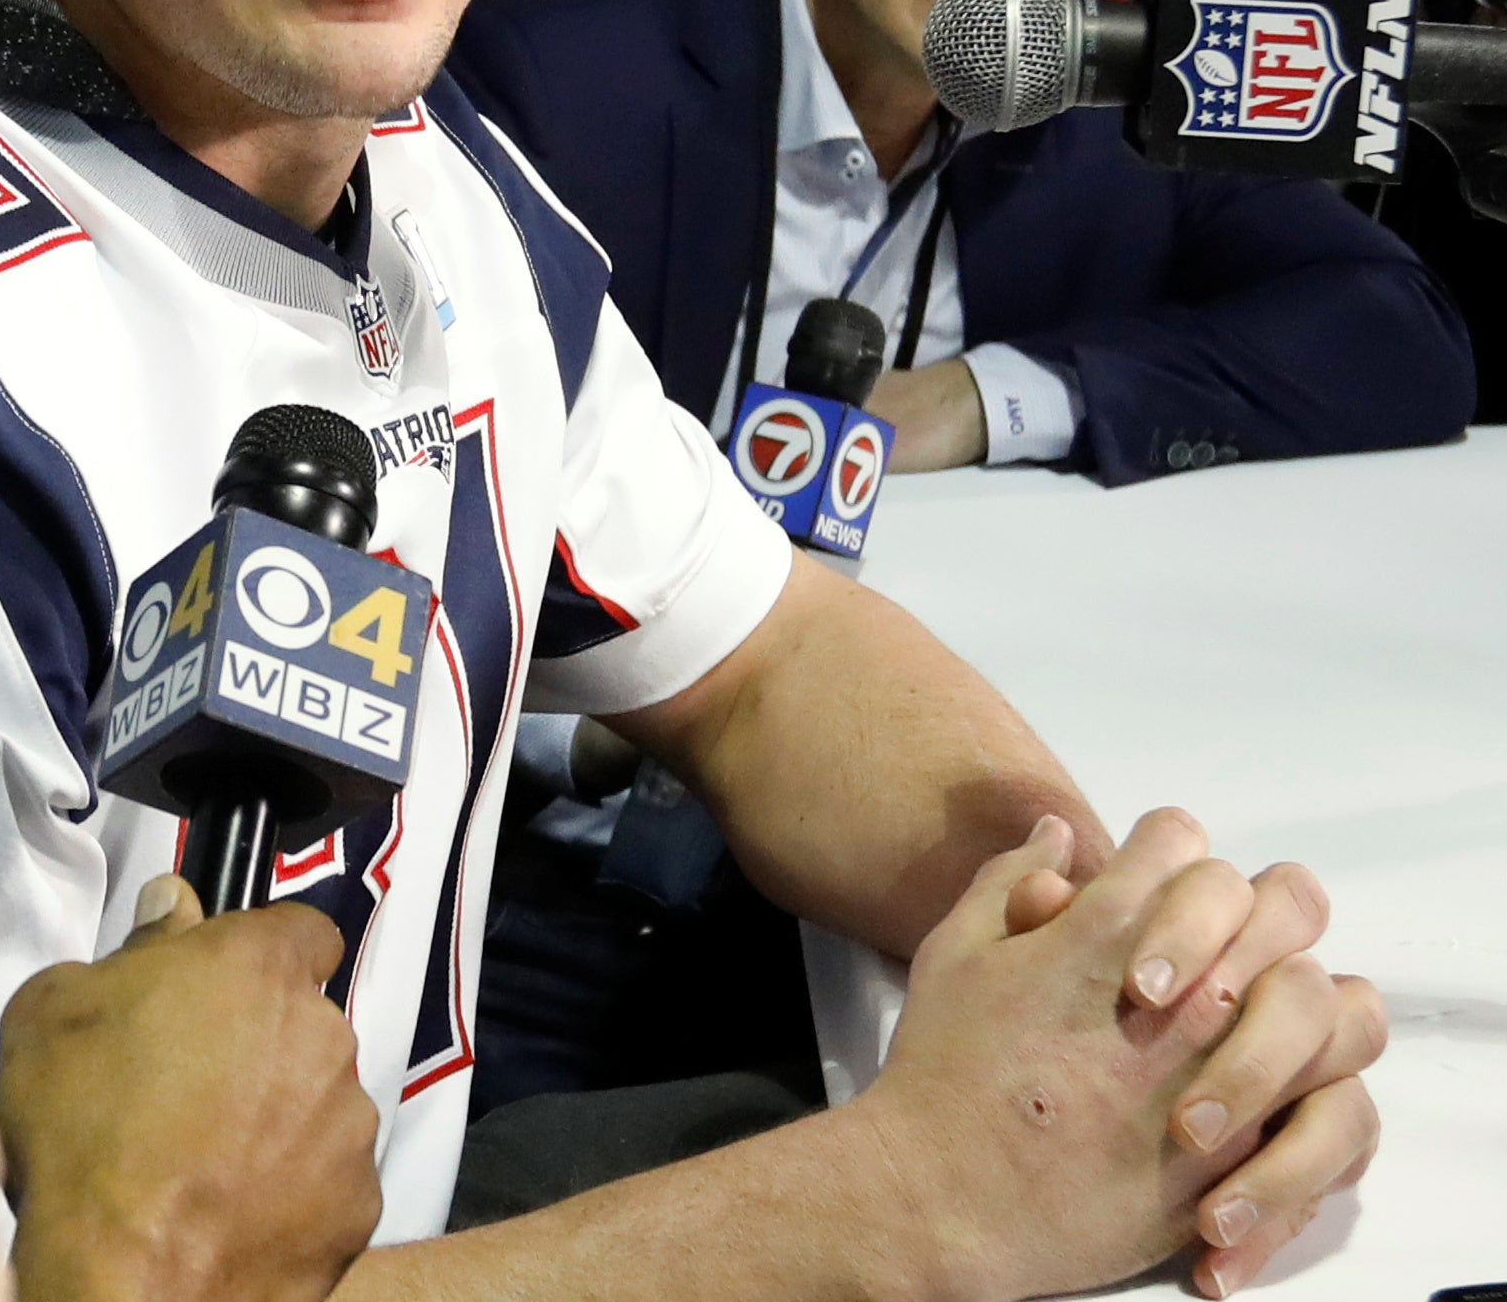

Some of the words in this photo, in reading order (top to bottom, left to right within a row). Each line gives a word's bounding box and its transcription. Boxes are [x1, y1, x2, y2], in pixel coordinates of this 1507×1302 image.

[1246, 19, 1327, 123] NFL
[370, 403, 455, 481] ATRIO
[815, 514, 863, 551] NEWS
[167, 540, 215, 639] 4
[328, 586, 413, 688] 4
[112, 652, 200, 744] WBZ
[229, 652, 393, 746] WBZ
